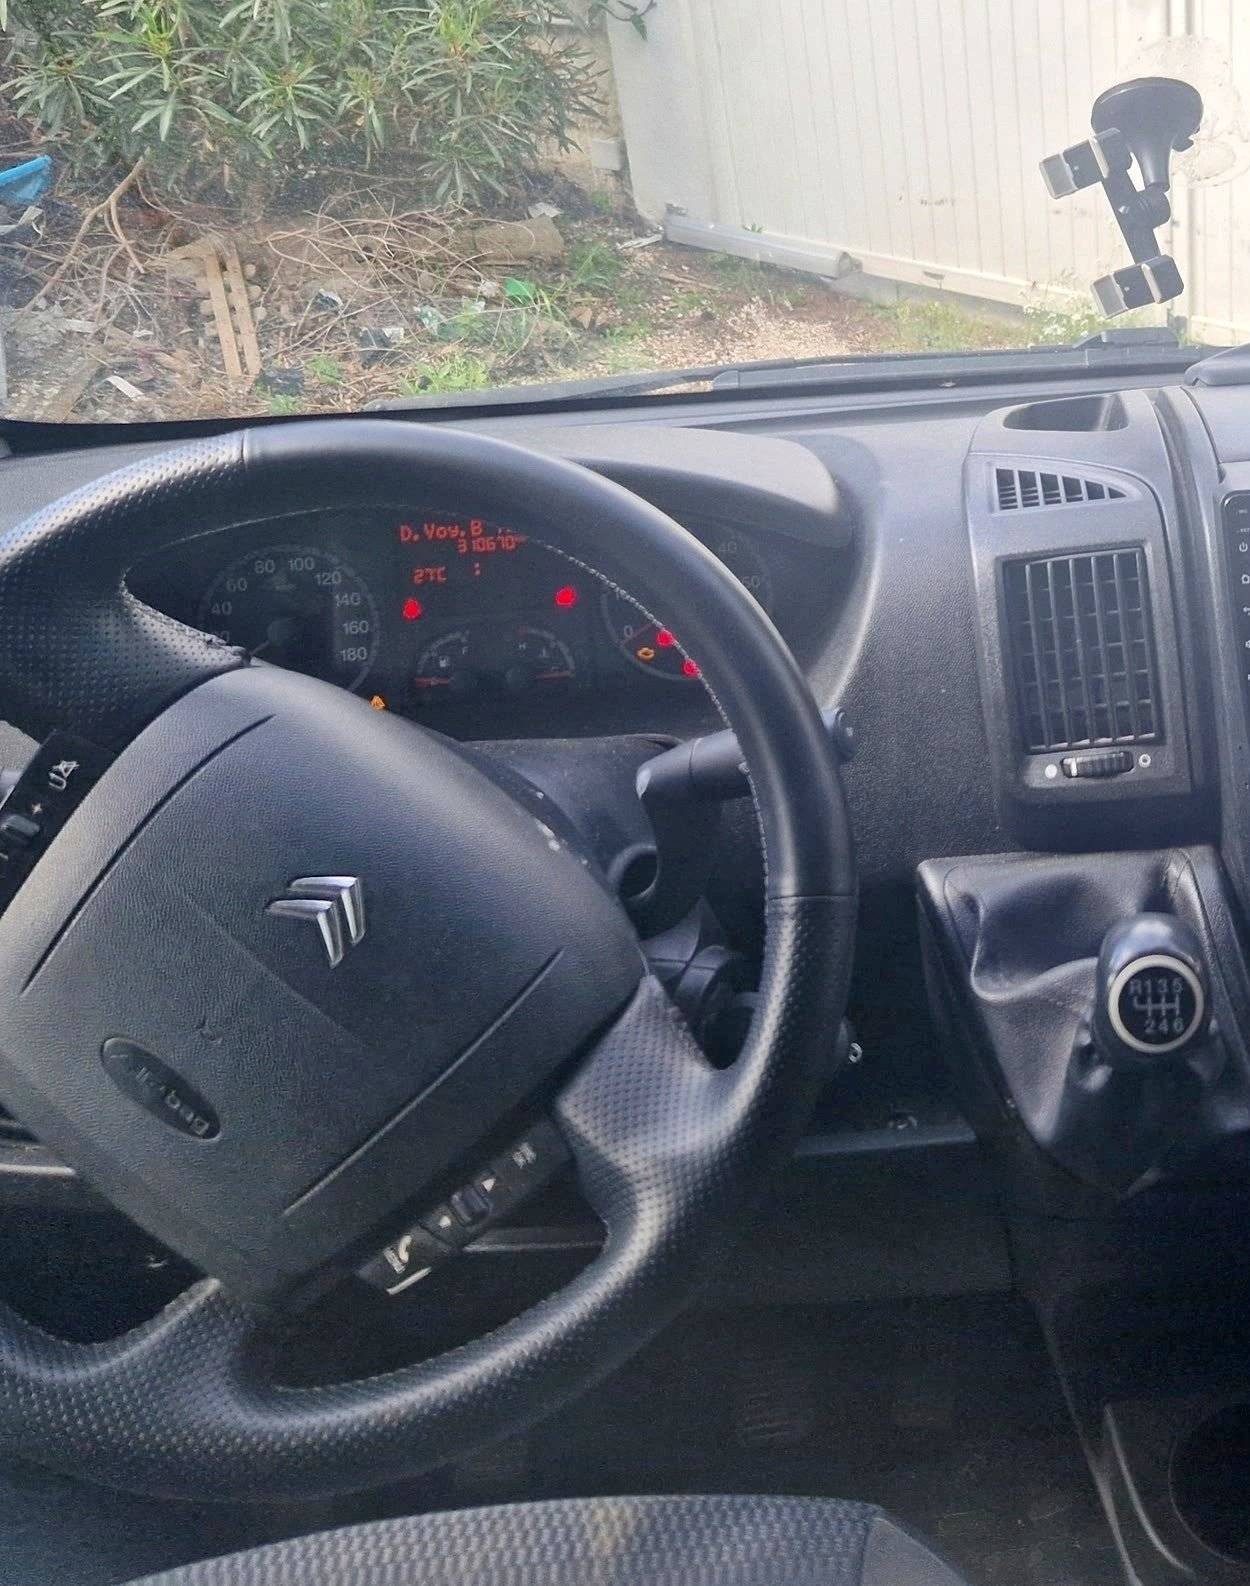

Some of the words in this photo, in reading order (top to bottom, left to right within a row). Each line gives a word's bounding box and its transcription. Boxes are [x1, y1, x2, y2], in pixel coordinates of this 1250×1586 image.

[254, 559, 276, 574] 80
[288, 557, 315, 571] 100
[226, 577, 248, 593] 60
[314, 570, 342, 586] 120
[210, 600, 232, 615] 40
[334, 592, 361, 608] 140
[342, 620, 369, 635] 160
[340, 646, 368, 662] 180
[1158, 978, 1168, 993] 3
[1144, 1019, 1155, 1033] 2
[1158, 1018, 1169, 1034] 4
[1173, 1017, 1184, 1034] 6
